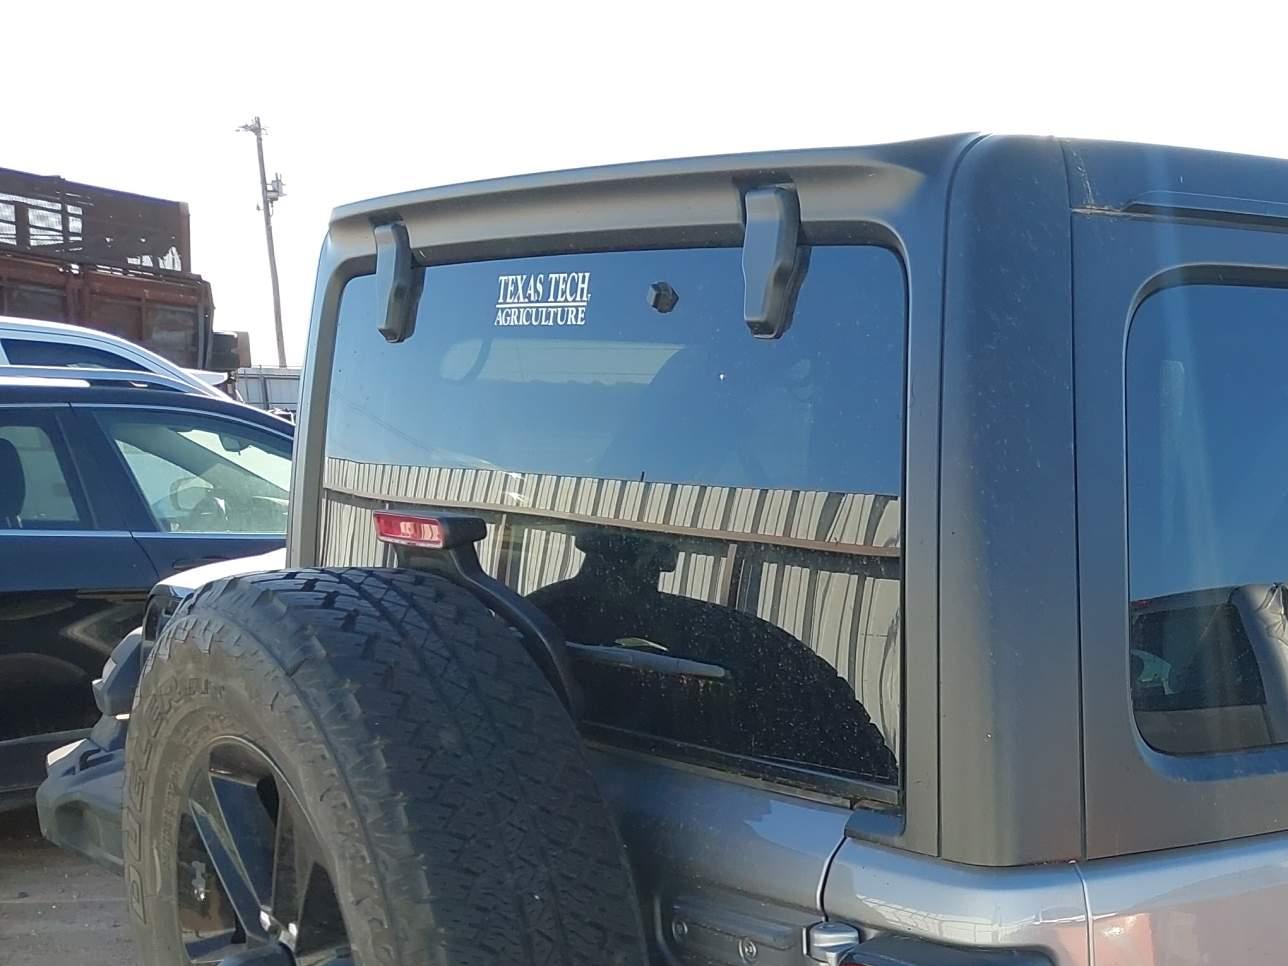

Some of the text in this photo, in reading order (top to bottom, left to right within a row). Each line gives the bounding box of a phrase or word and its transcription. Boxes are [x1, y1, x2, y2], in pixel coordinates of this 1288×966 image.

[498, 272, 590, 303] TEXAS TECH
[494, 307, 586, 326] AGRICULTURE
